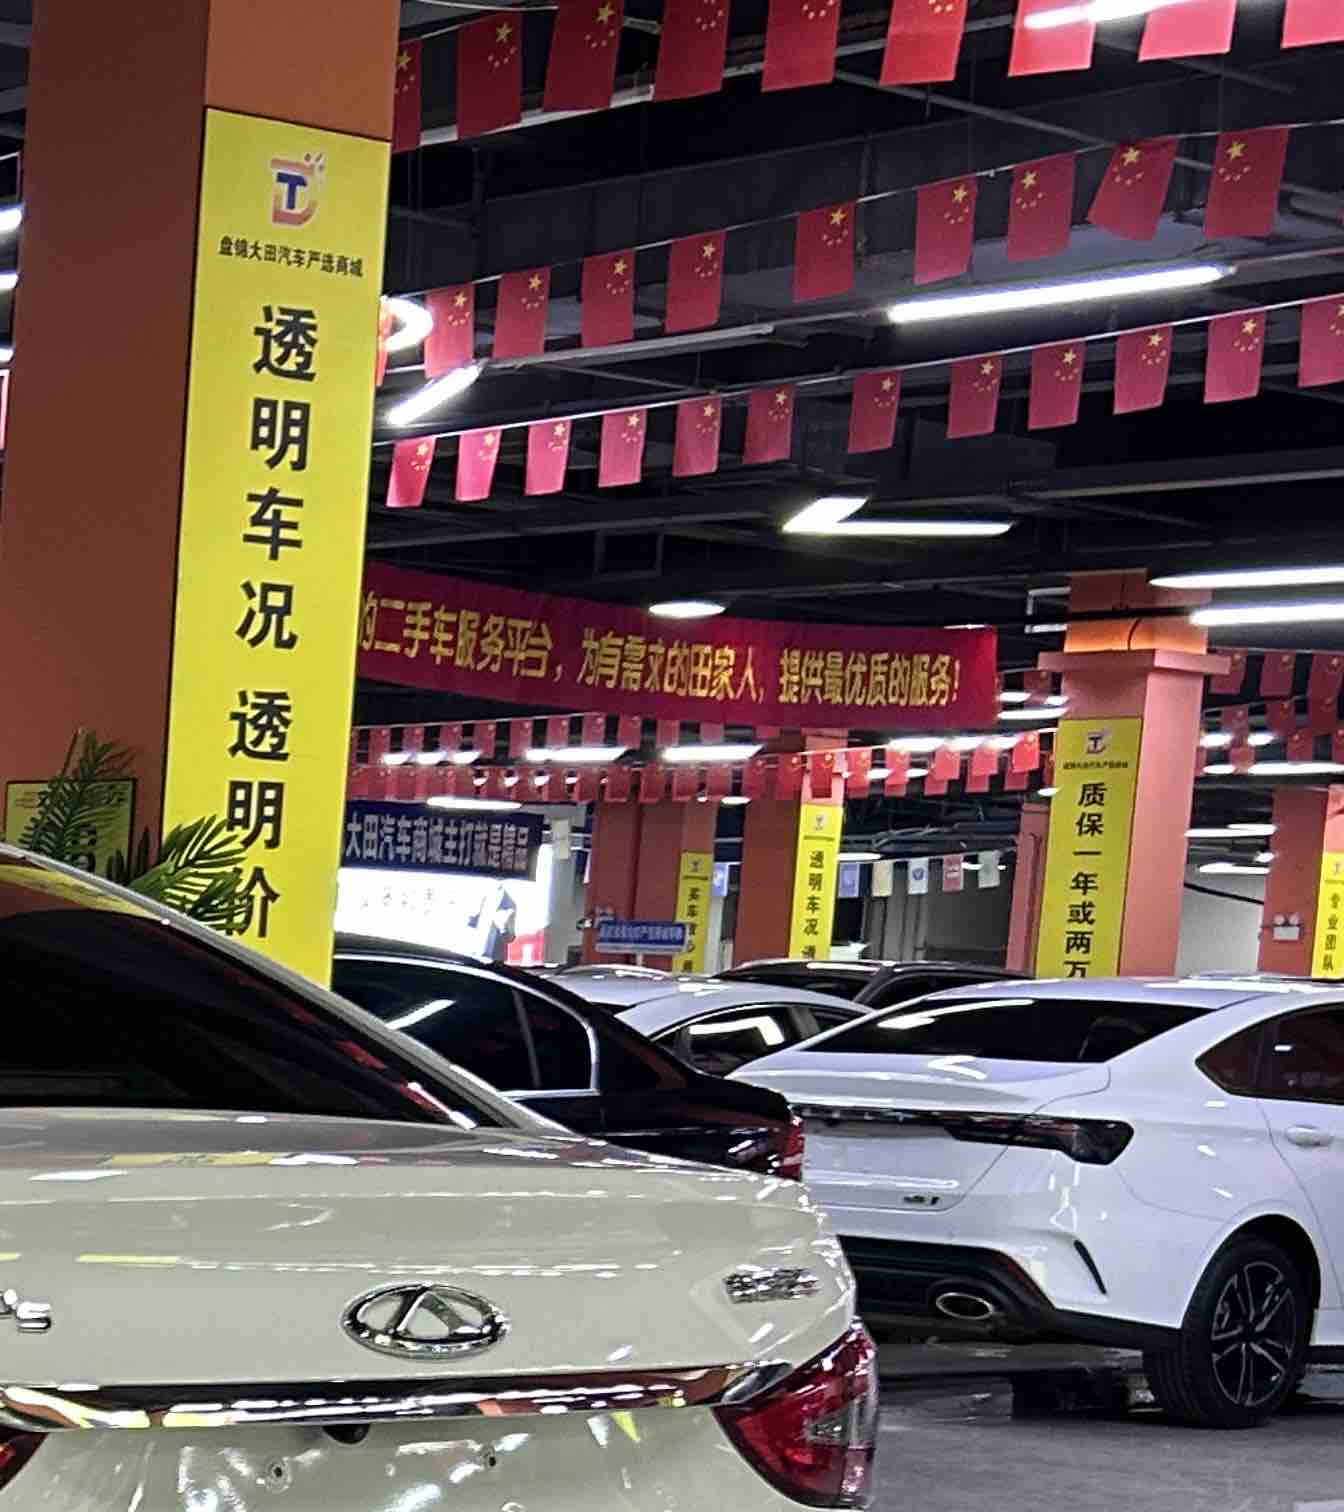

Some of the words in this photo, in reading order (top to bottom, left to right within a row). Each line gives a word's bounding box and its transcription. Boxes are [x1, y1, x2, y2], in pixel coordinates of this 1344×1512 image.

[1064, 783, 1108, 978] 质保一年或两万
